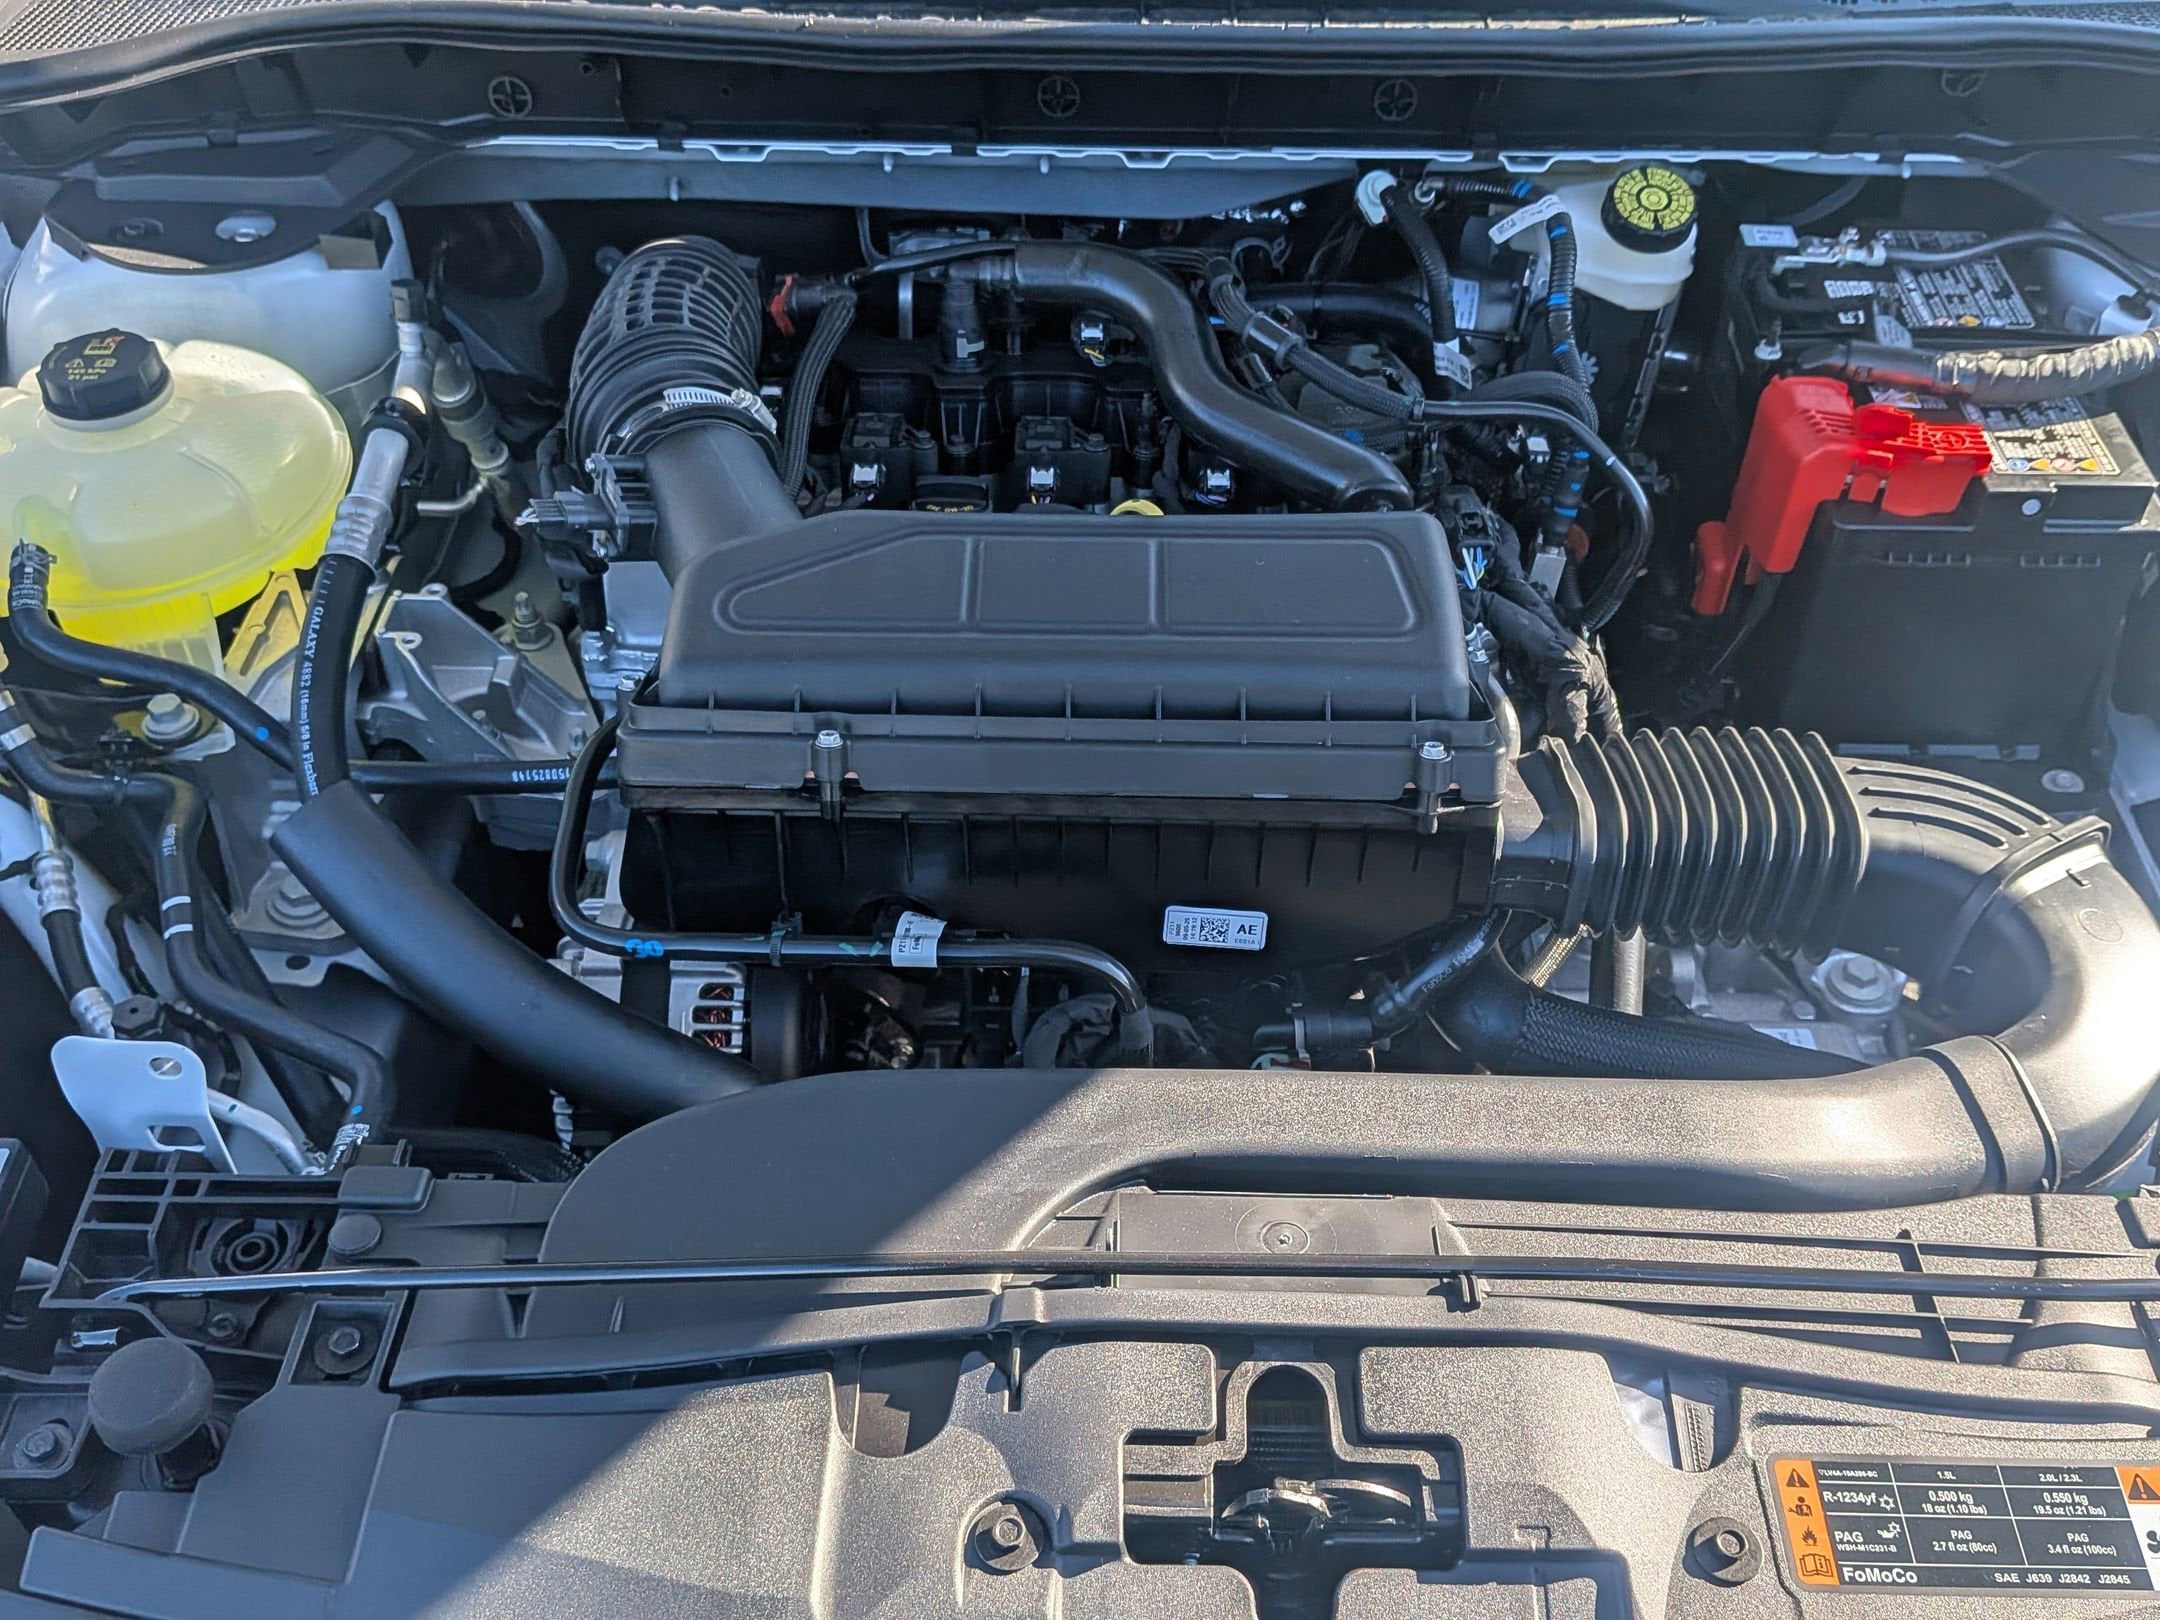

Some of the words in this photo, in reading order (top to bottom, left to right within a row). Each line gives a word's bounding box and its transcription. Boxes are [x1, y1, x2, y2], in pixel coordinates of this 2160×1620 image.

[304, 606, 324, 659] GALAXY
[299, 661, 313, 688] 4882
[1236, 924, 1258, 936] AE
[1936, 1471, 1957, 1480] 1.5L
[2038, 1473, 2059, 1482] 2.0L
[2063, 1474, 2084, 1483] 2.3L
[1822, 1490, 1877, 1506] R-1234yf
[1928, 1490, 1958, 1502] 0.500
[1958, 1491, 1974, 1505] kg
[2043, 1492, 2073, 1504] 0.550
[2073, 1492, 2089, 1506] kg
[1921, 1503, 1934, 1513] 18
[1946, 1503, 1969, 1515] (1.10
[1969, 1504, 1988, 1516] lbs)
[2032, 1505, 2052, 1515] 19.5
[2053, 1507, 2065, 1515] oz
[2065, 1505, 2087, 1516] (1.21
[2088, 1506, 2107, 1517] lbs)
[1834, 1531, 1864, 1543] PAG
[1950, 1529, 1973, 1540] PAG
[2066, 1532, 2090, 1543] PAG
[1932, 1541, 1947, 1551] 2.7
[1947, 1541, 1956, 1551] fl
[1956, 1543, 1969, 1552] oz
[1969, 1542, 1998, 1554] (80cc)
[2046, 1544, 2063, 1554] 3.4
[2063, 1544, 2071, 1554] fl
[2071, 1546, 2083, 1554] oz
[2083, 1545, 2118, 1557] (100cc)
[1842, 1566, 1919, 1584] FoMoCo
[1994, 1572, 2021, 1583] SAE
[2025, 1573, 2053, 1583] J639
[2058, 1573, 2092, 1584] J2842
[2098, 1574, 2132, 1584] J2845
